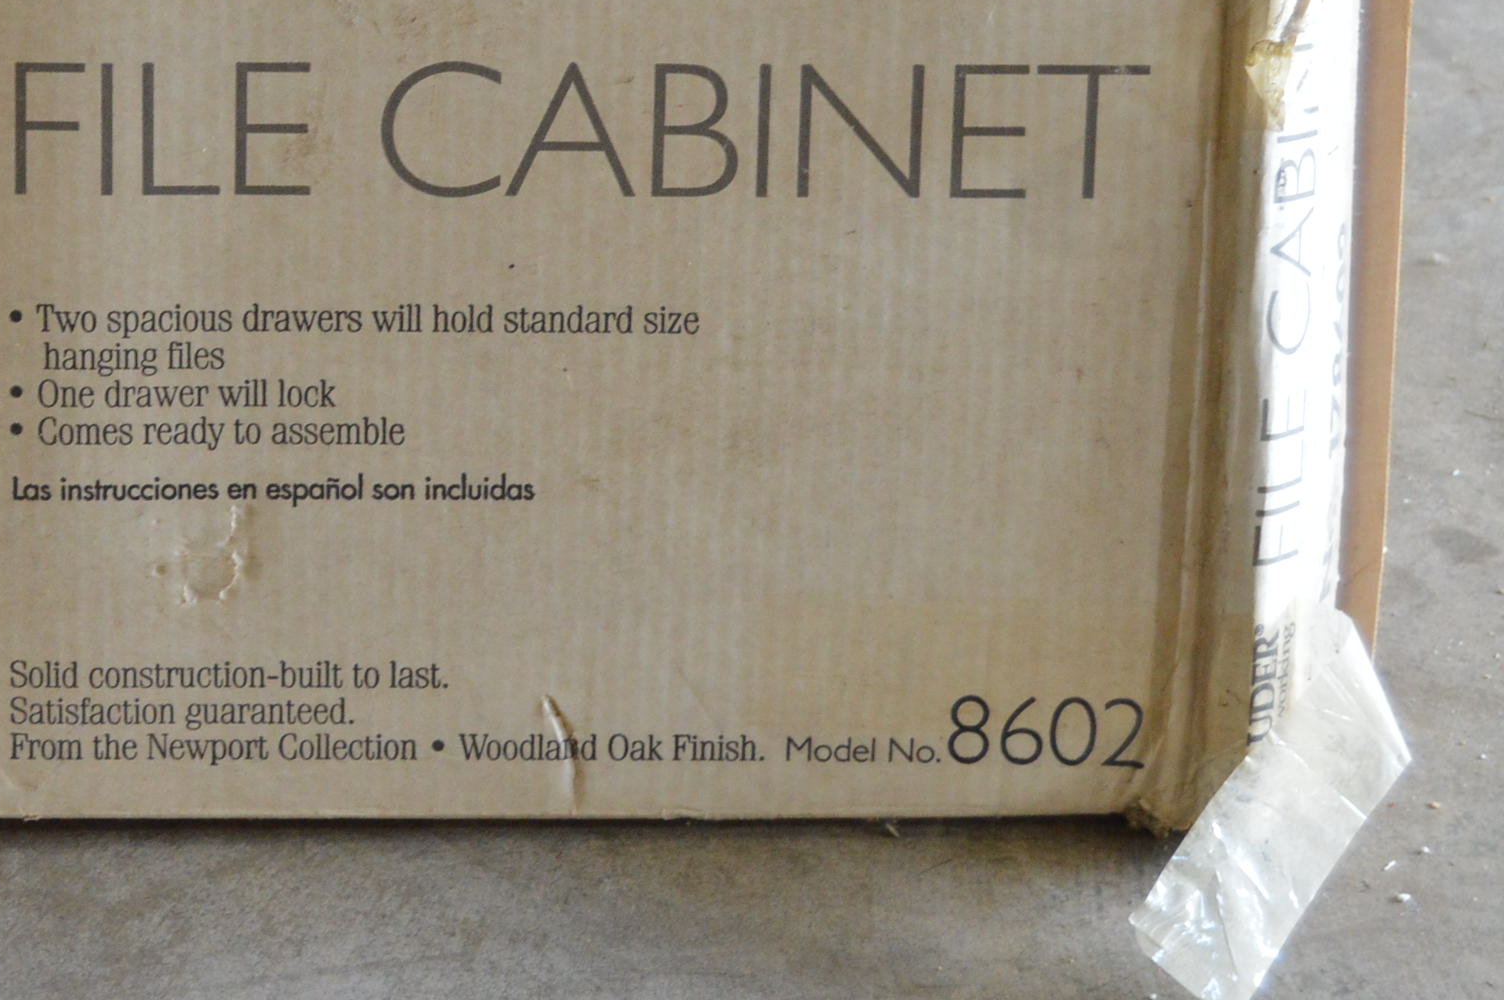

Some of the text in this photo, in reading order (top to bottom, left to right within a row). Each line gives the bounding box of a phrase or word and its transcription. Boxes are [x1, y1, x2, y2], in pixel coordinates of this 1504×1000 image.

[14, 60, 1152, 200] FILE CABINET
[35, 302, 700, 338] Two spacious drawers will hold standard size
[42, 340, 226, 376] hanging files
[37, 378, 337, 409] One drawer will lock
[37, 415, 406, 452] Comes ready to assemble
[11, 472, 537, 508] Las instrucciones en español son incluidas
[1252, 397, 1306, 569] FILE
[9, 659, 449, 690] Solid construction-built to last.
[1247, 630, 1279, 746] UDER
[9, 695, 355, 730] Satisfaction guaranteed.
[9, 730, 765, 768] From the Newport Collection Woodland Oak Finish.
[785, 694, 1145, 769] Model No. 8602
